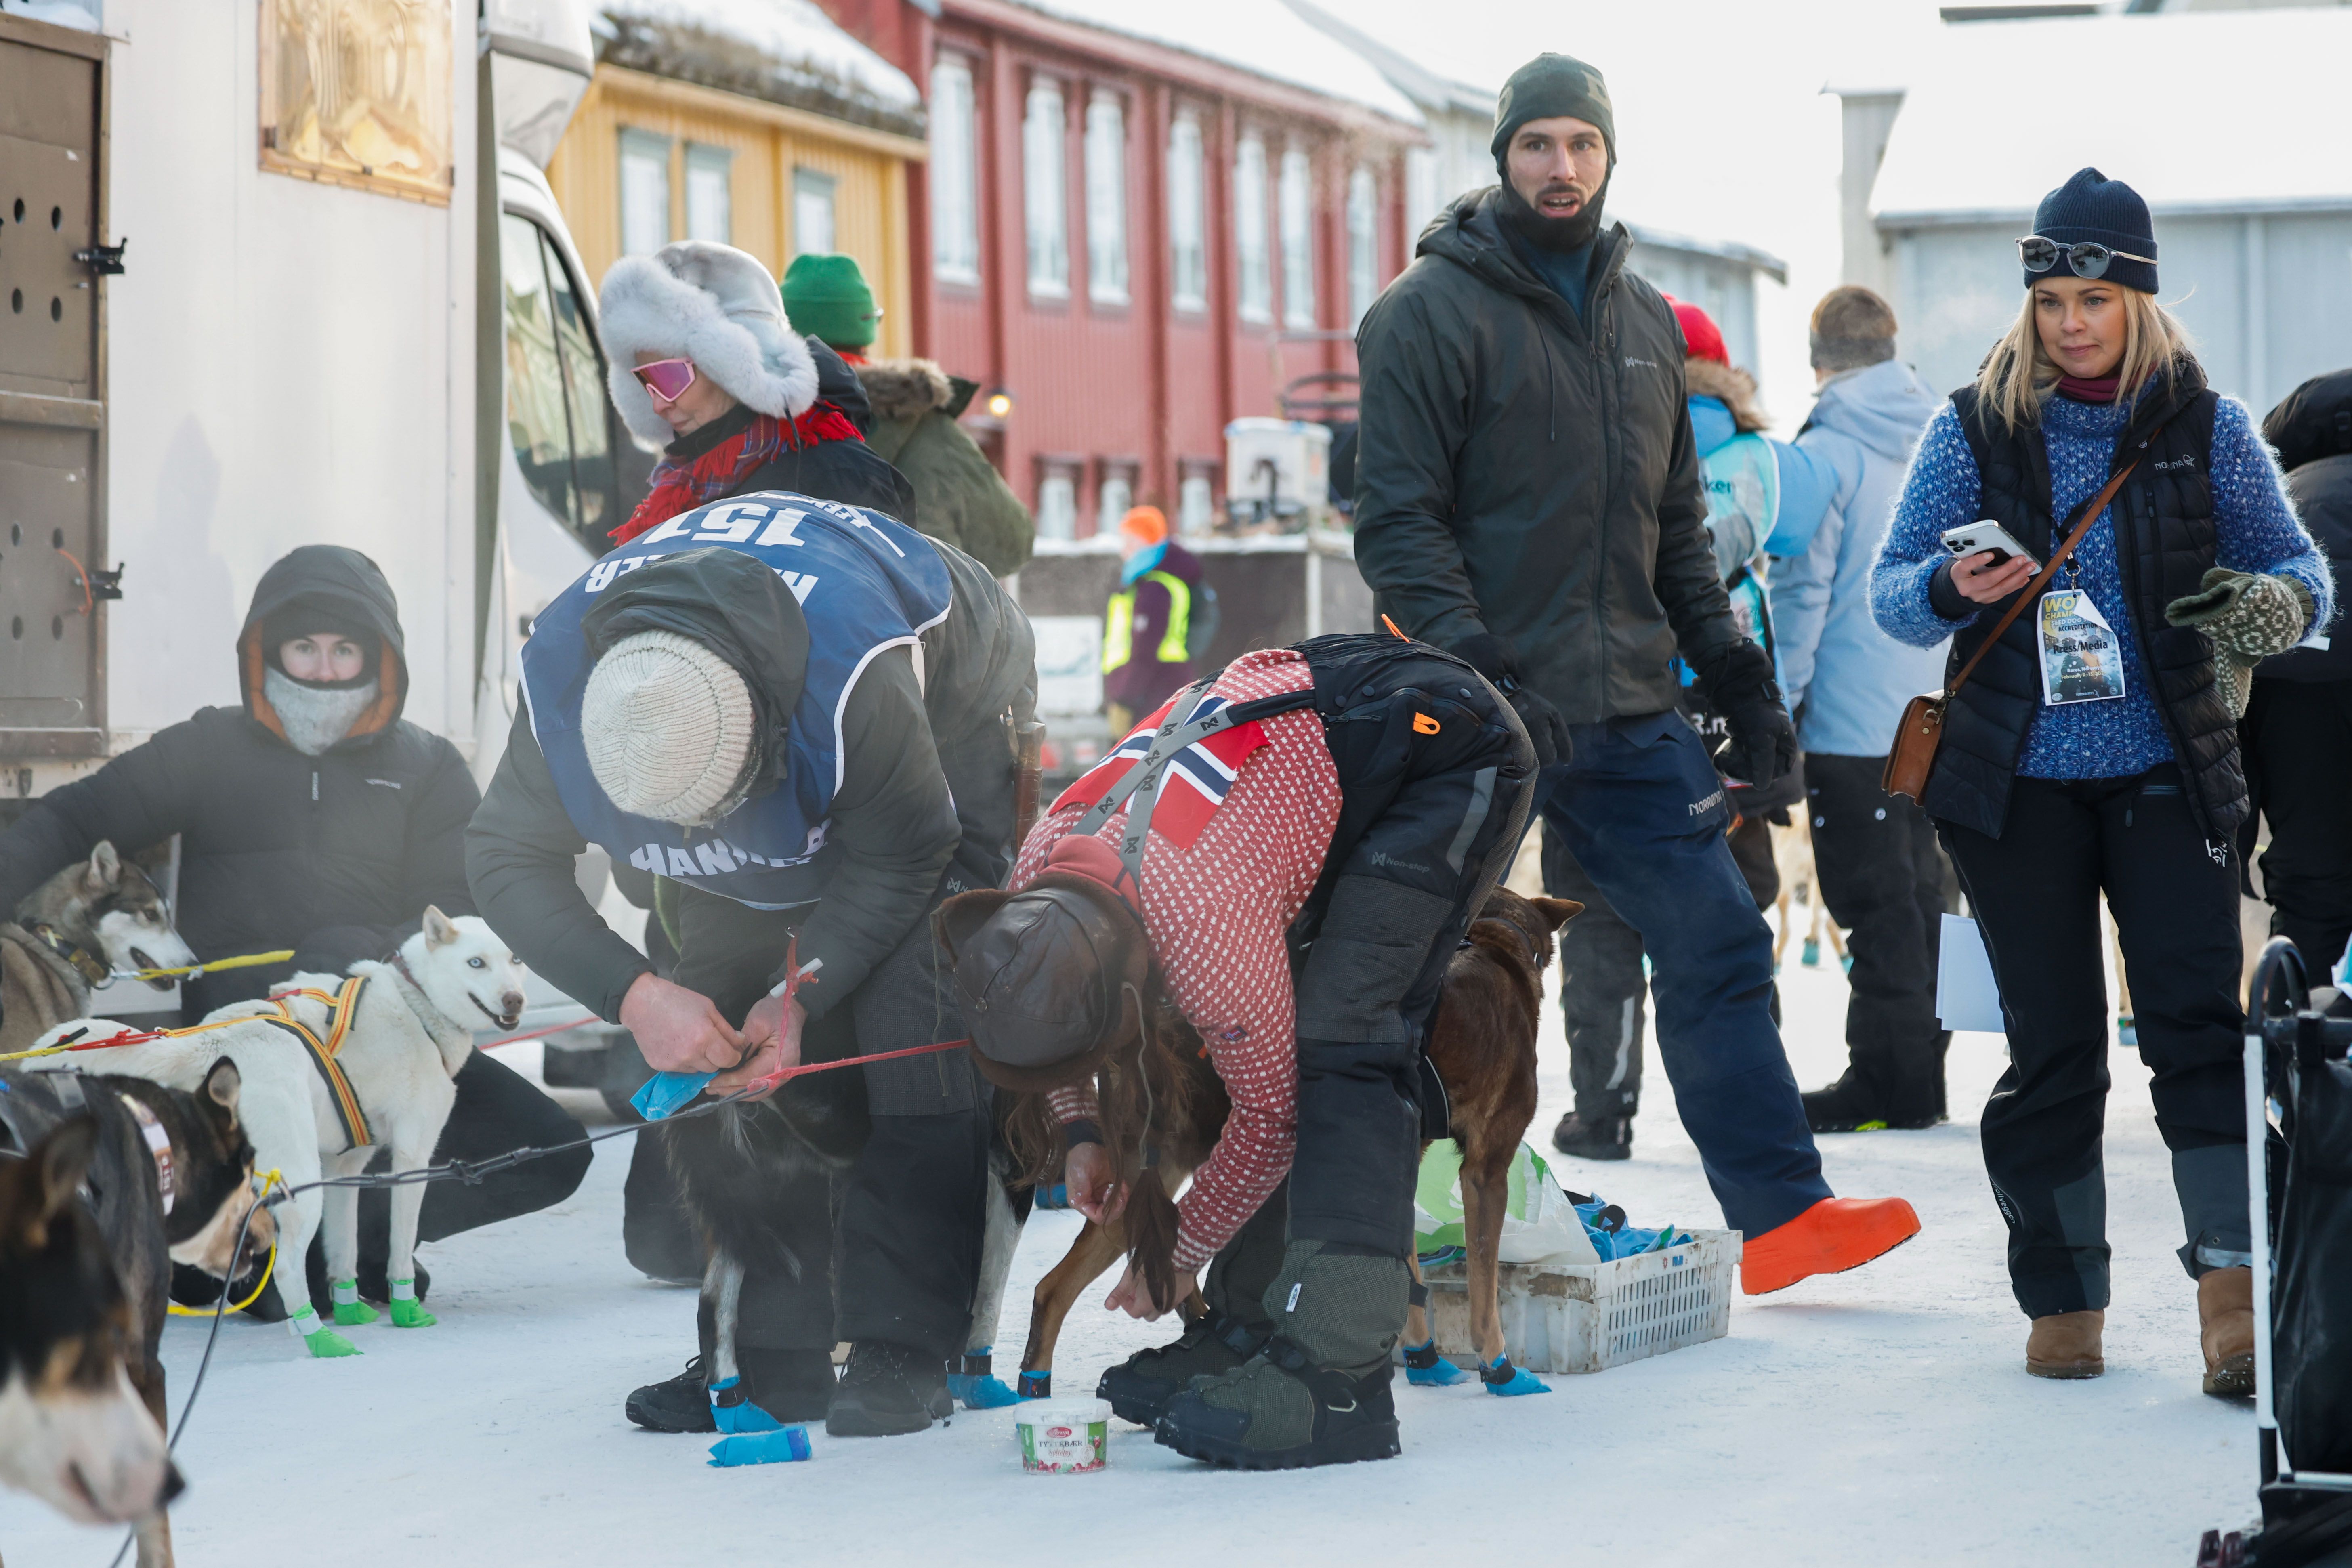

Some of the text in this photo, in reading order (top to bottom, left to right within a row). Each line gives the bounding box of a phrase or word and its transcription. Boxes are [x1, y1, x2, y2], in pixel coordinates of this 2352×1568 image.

[2155, 460, 2185, 471] NONA
[643, 503, 811, 547] 151
[2053, 640, 2108, 654] Press/Media
[1688, 790, 1722, 816] NORRØNA
[1386, 856, 1430, 873] Non-stop
